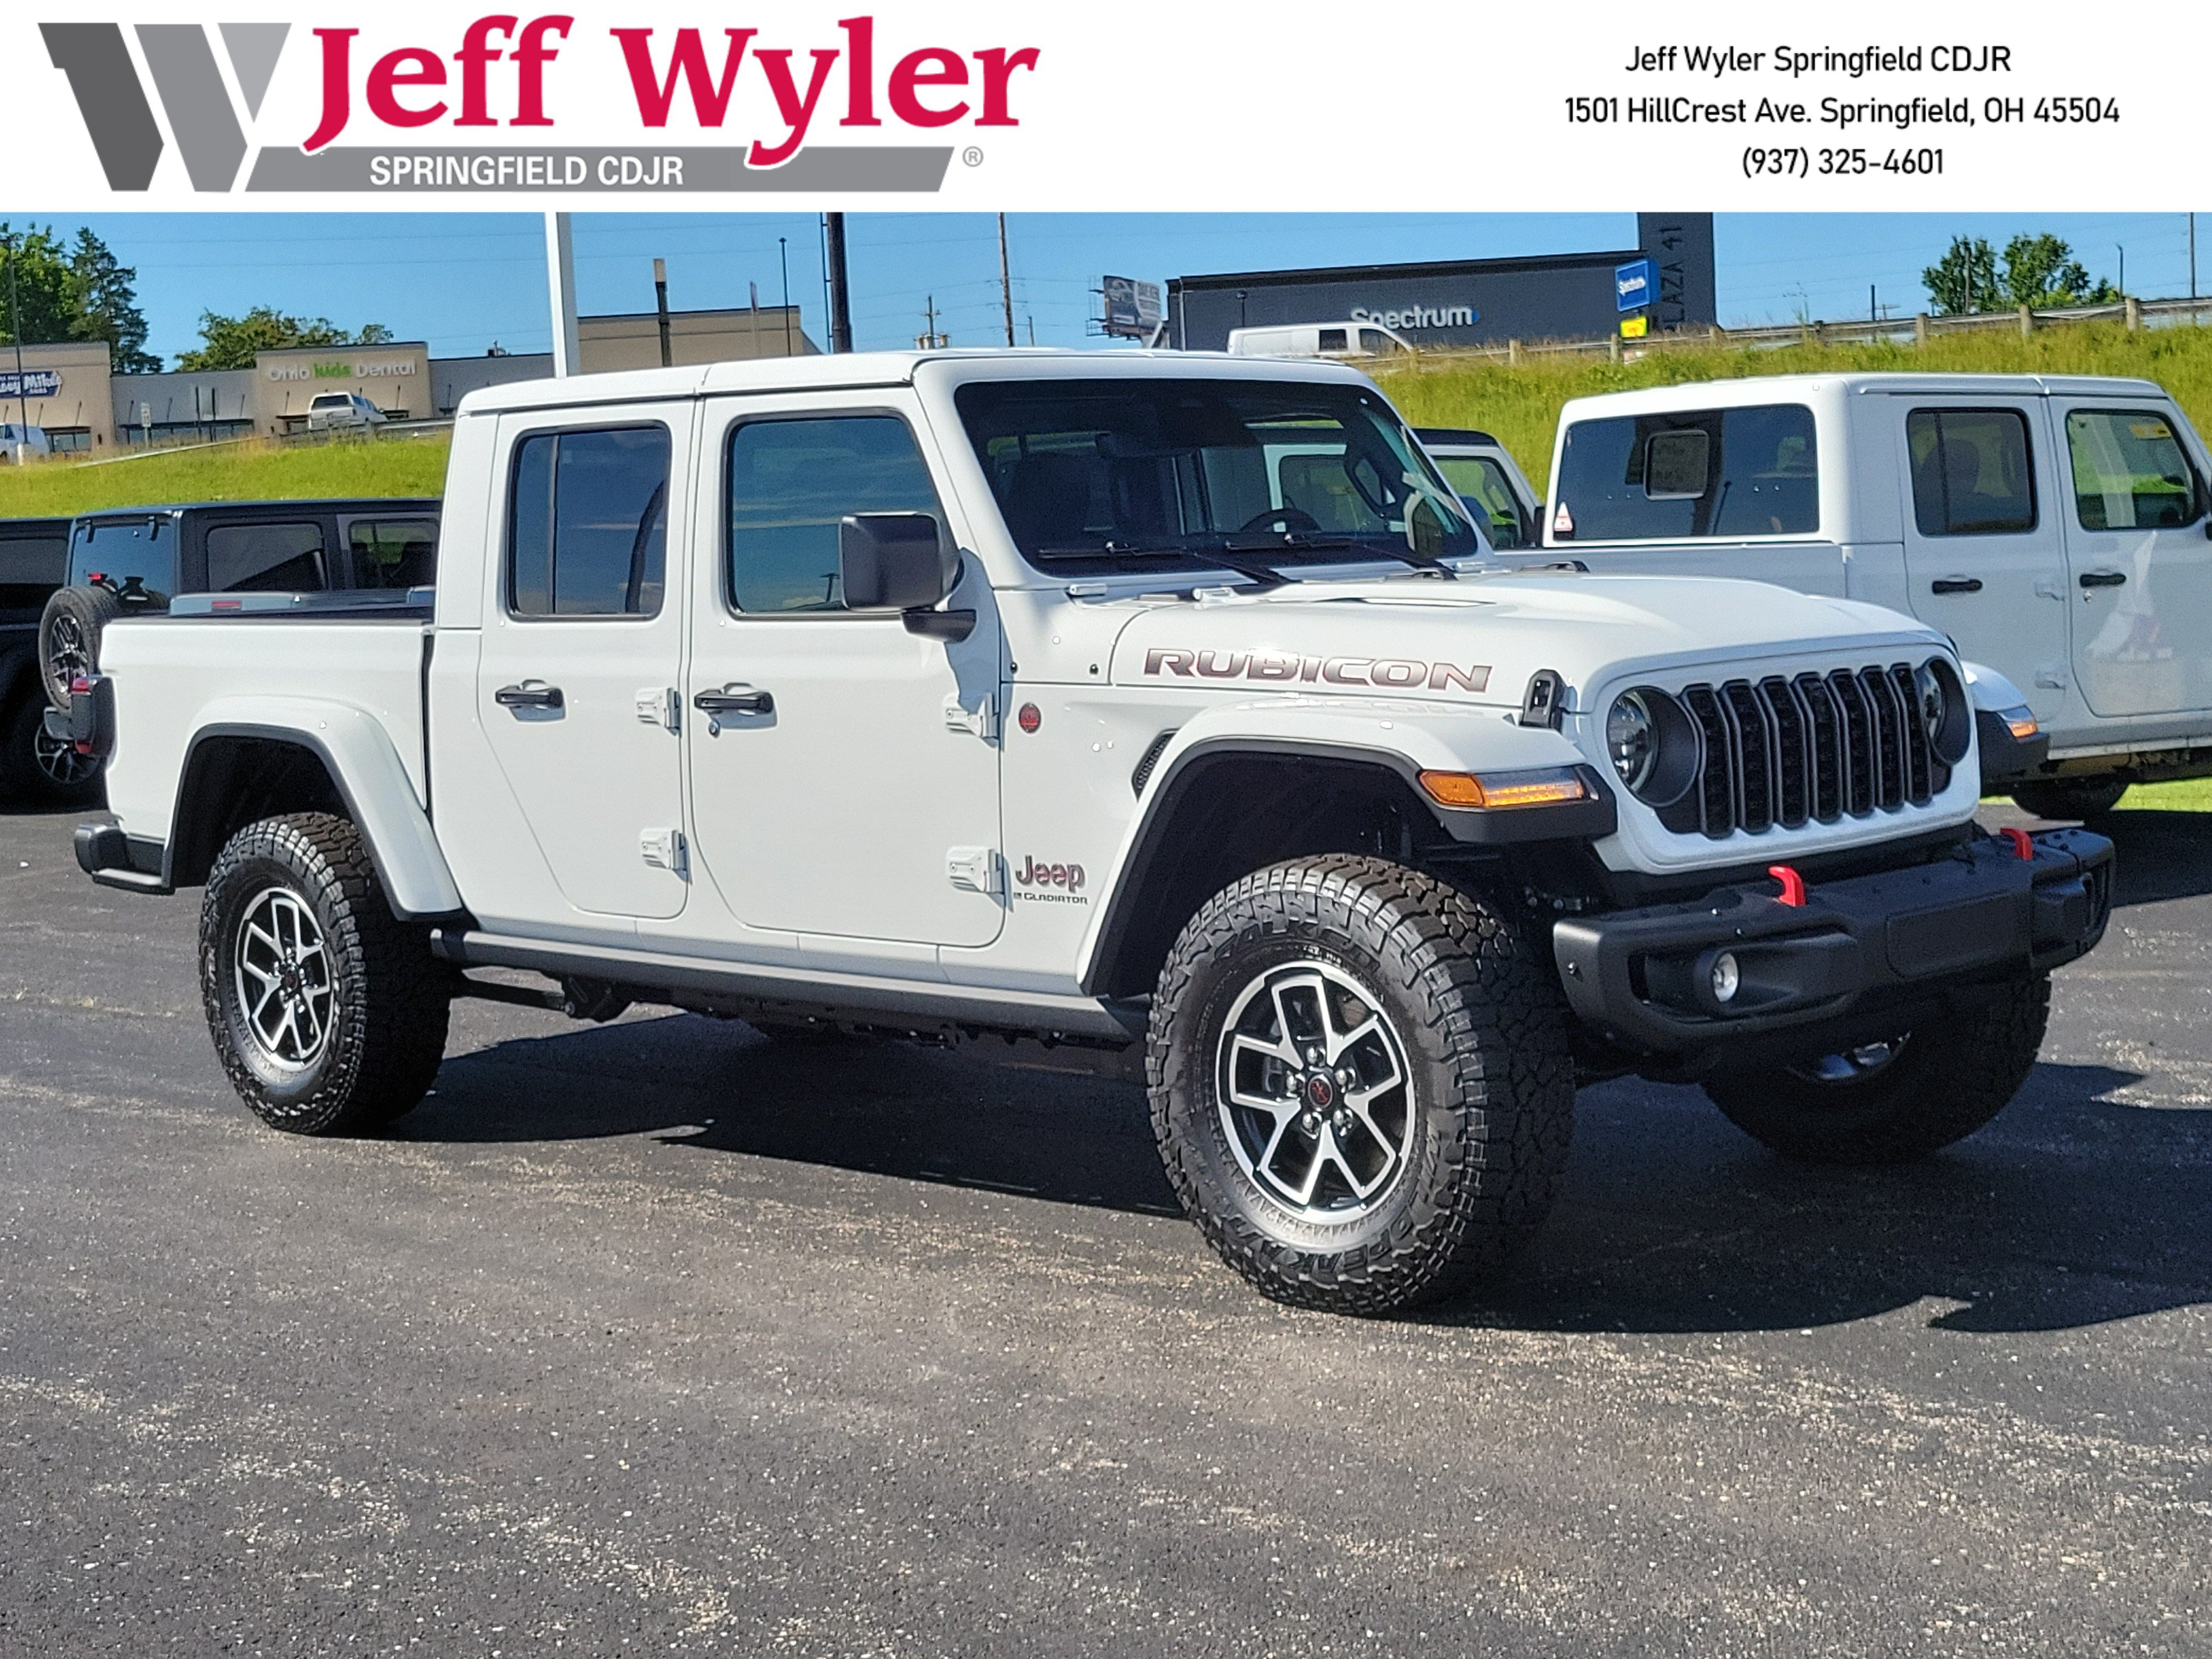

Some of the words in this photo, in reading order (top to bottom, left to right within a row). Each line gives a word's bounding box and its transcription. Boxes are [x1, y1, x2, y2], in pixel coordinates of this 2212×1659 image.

[1350, 304, 1472, 329] Spectrum
[357, 359, 416, 379] Dental
[1144, 647, 1493, 693] RUBICON
[1015, 855, 1086, 894] Jeep
[1024, 892, 1088, 905] GLADIATOR
